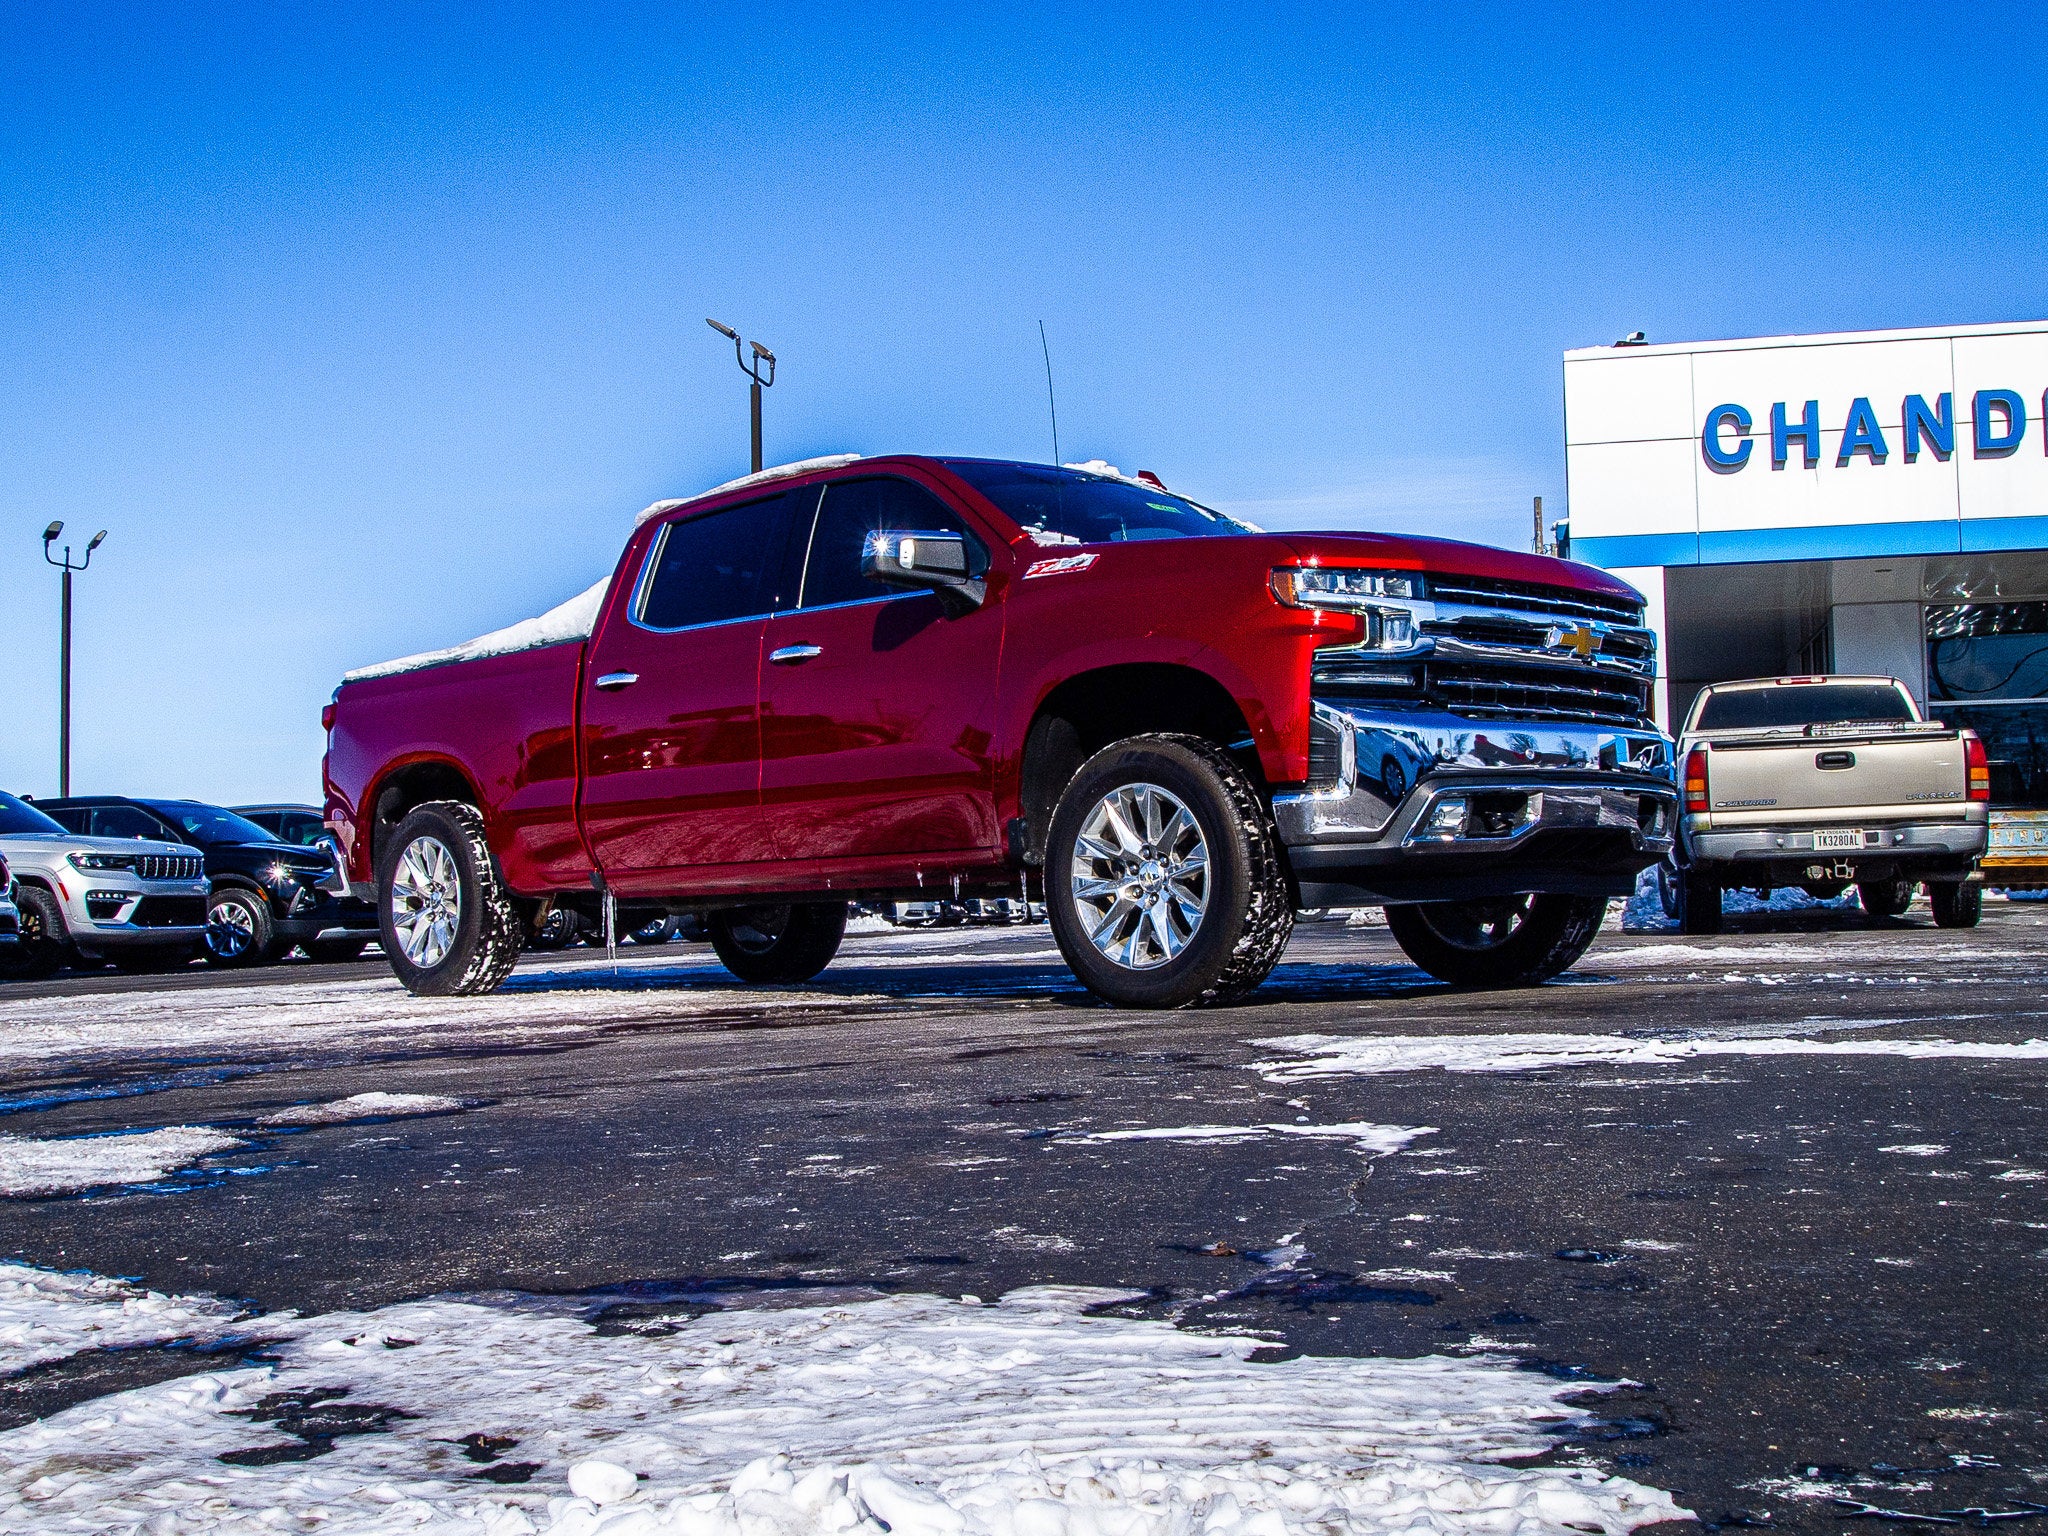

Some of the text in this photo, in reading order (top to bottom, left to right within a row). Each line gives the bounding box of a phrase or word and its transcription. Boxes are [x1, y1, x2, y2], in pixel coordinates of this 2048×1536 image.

[1702, 387, 2048, 475] CHAND
[1726, 798, 1777, 808] SILVERADO
[1818, 834, 1860, 847] TK3280AL
